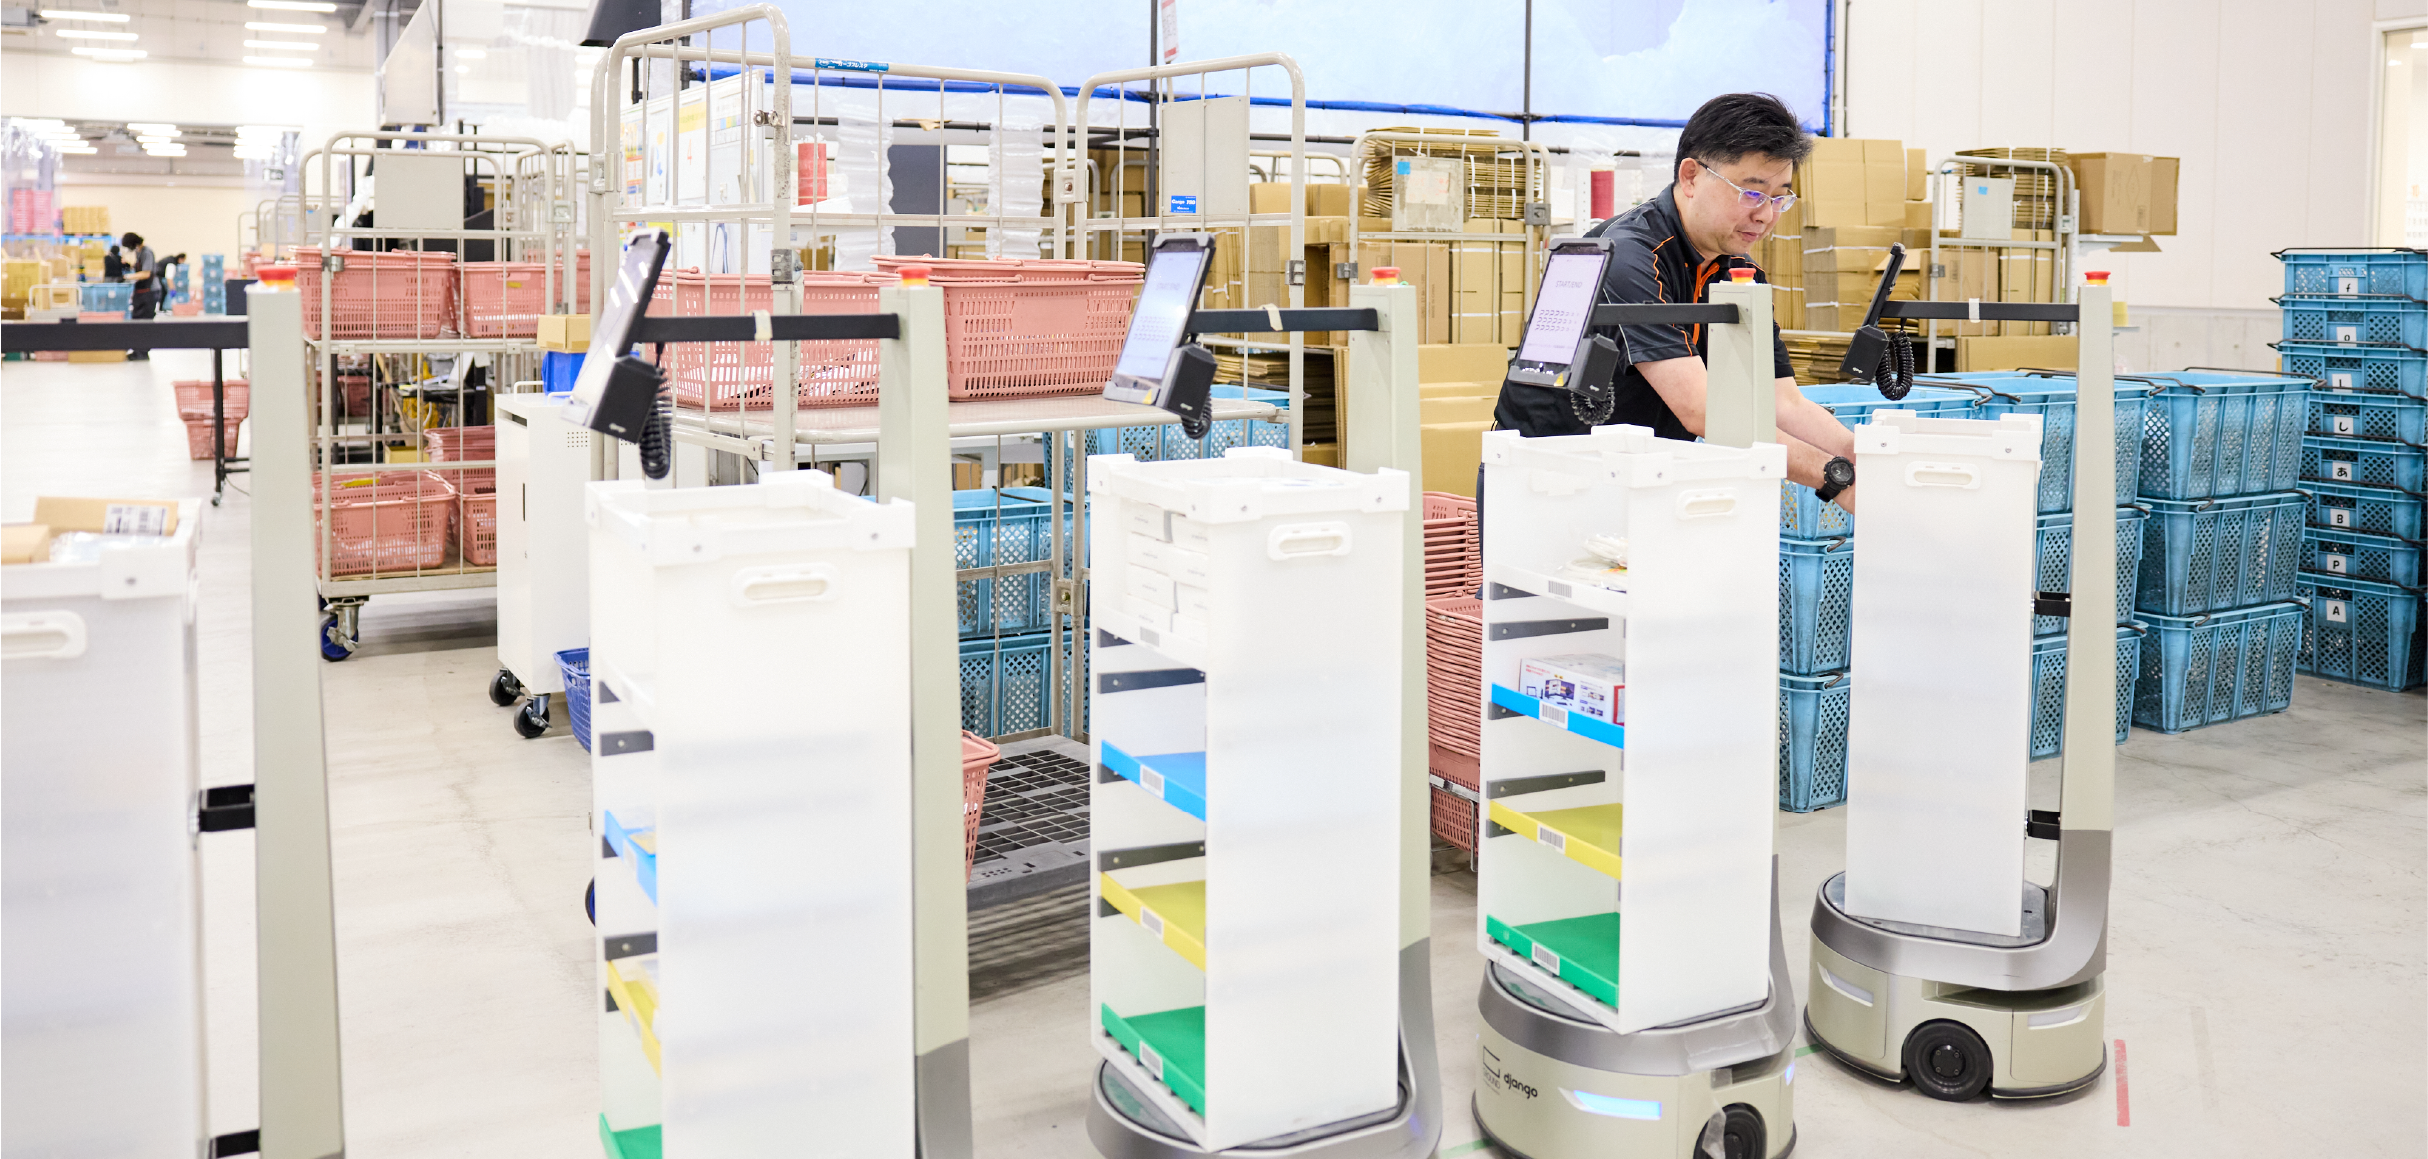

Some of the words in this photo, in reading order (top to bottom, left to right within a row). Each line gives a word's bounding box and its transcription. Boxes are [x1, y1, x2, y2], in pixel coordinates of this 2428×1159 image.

[2337, 467, 2347, 477] あ
[2336, 514, 2343, 523] B
[2333, 560, 2340, 569] P
[2332, 606, 2340, 615] A
[1503, 1072, 1538, 1100] django
